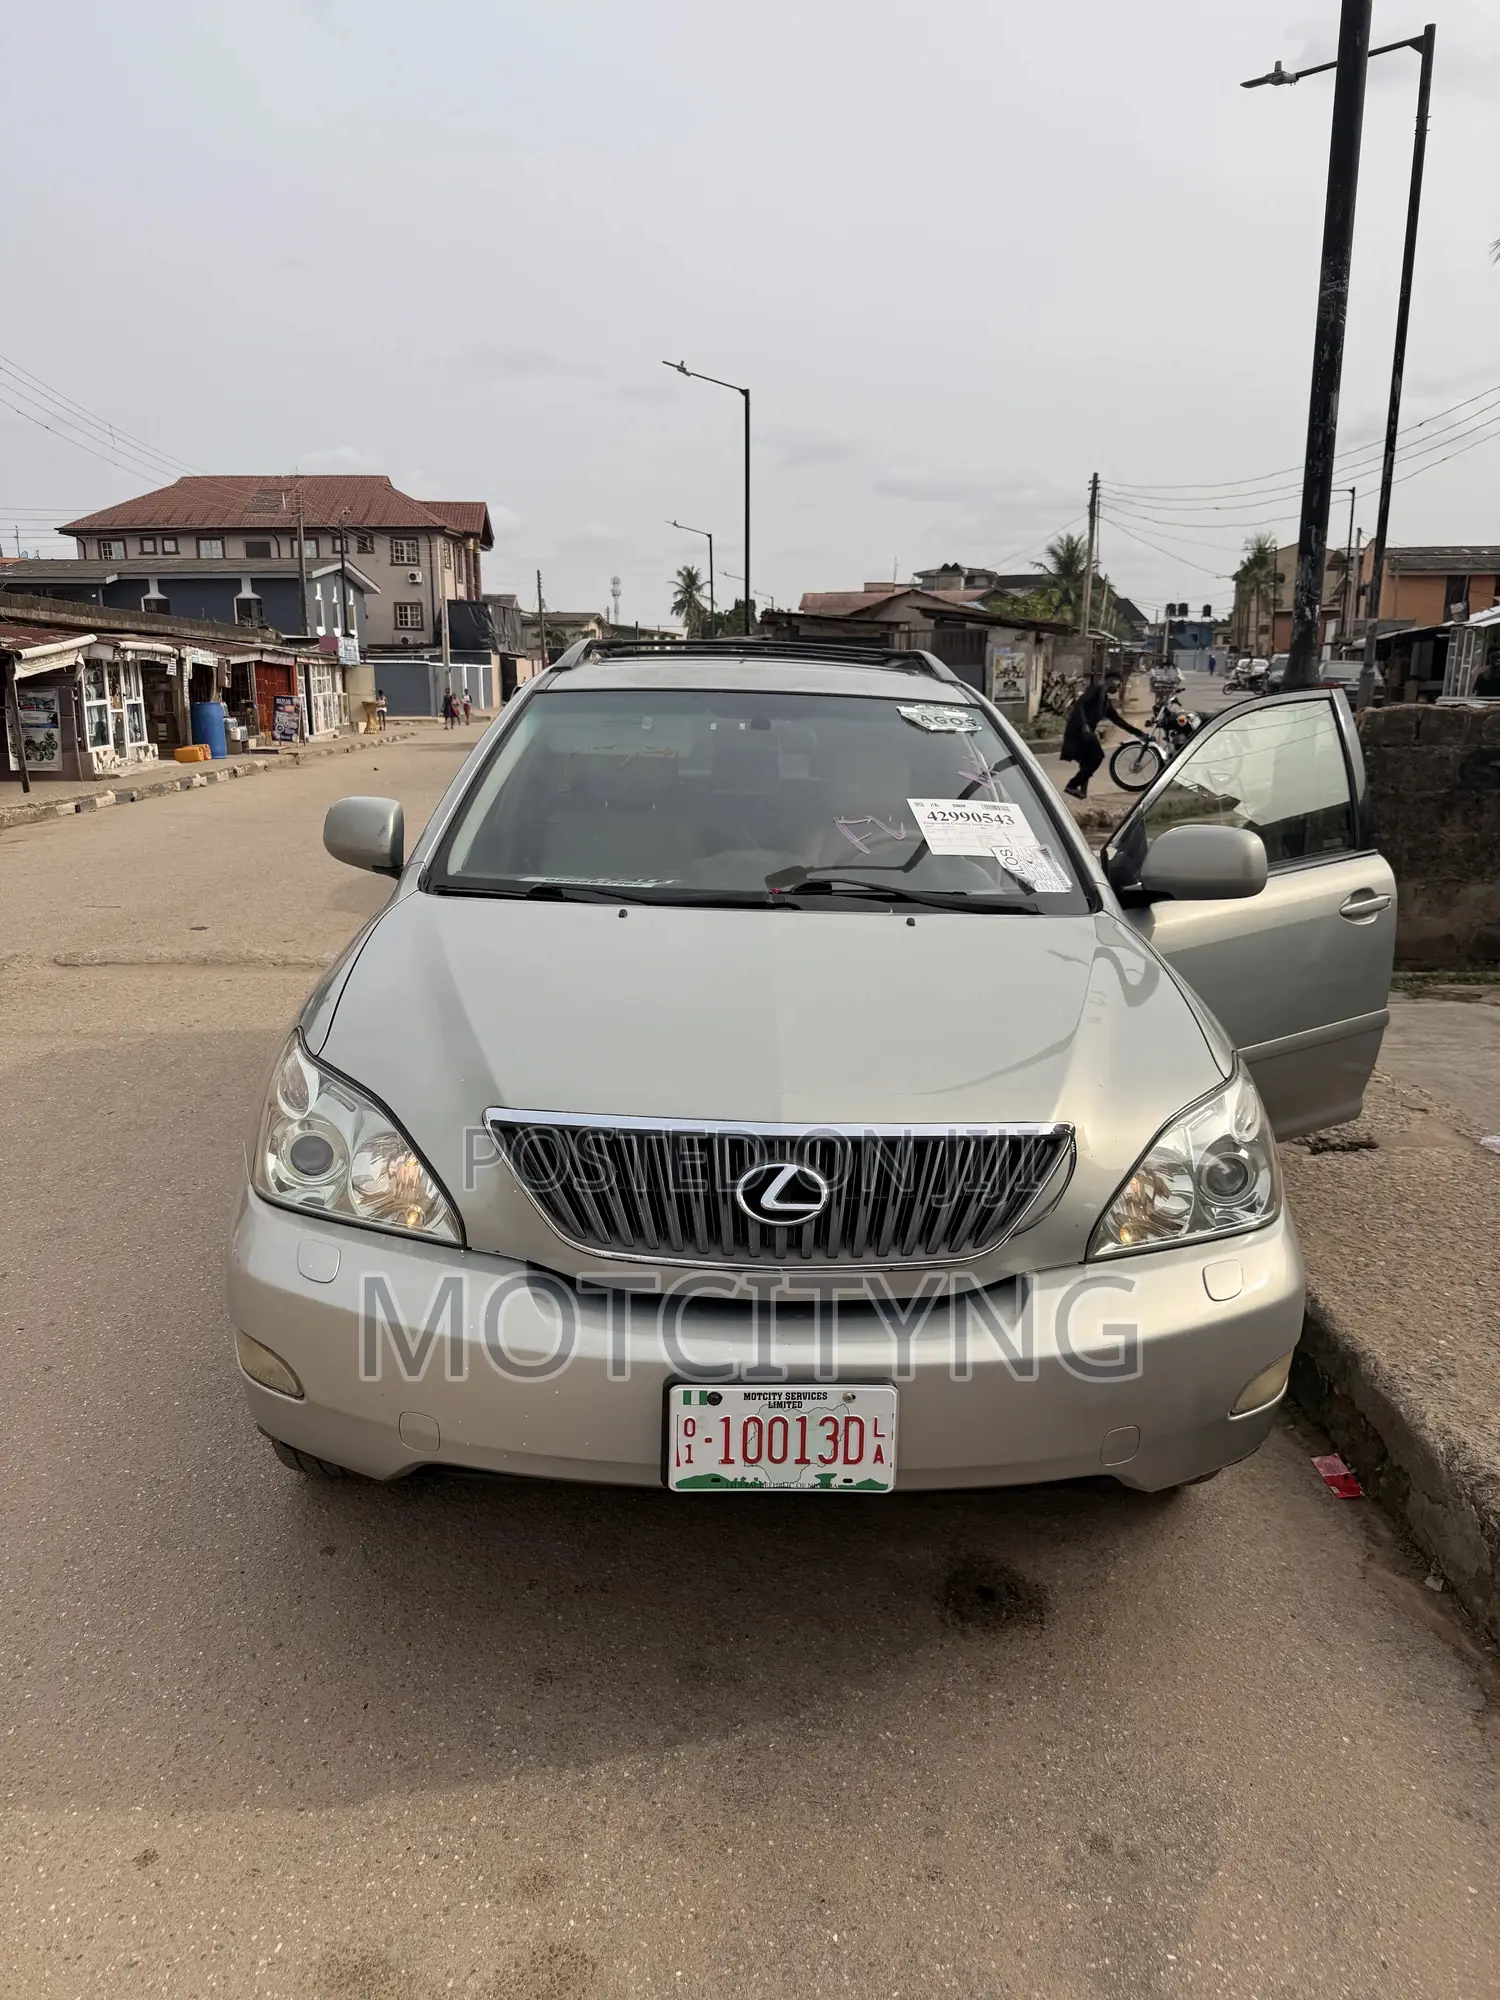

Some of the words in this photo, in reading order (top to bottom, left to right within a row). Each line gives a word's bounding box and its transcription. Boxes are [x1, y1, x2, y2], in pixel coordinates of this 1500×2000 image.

[927, 810, 1015, 826] 42990543
[743, 1391, 783, 1401] MOTCITY
[785, 1391, 828, 1401] SERVICES
[767, 1400, 803, 1409] LIMITED
